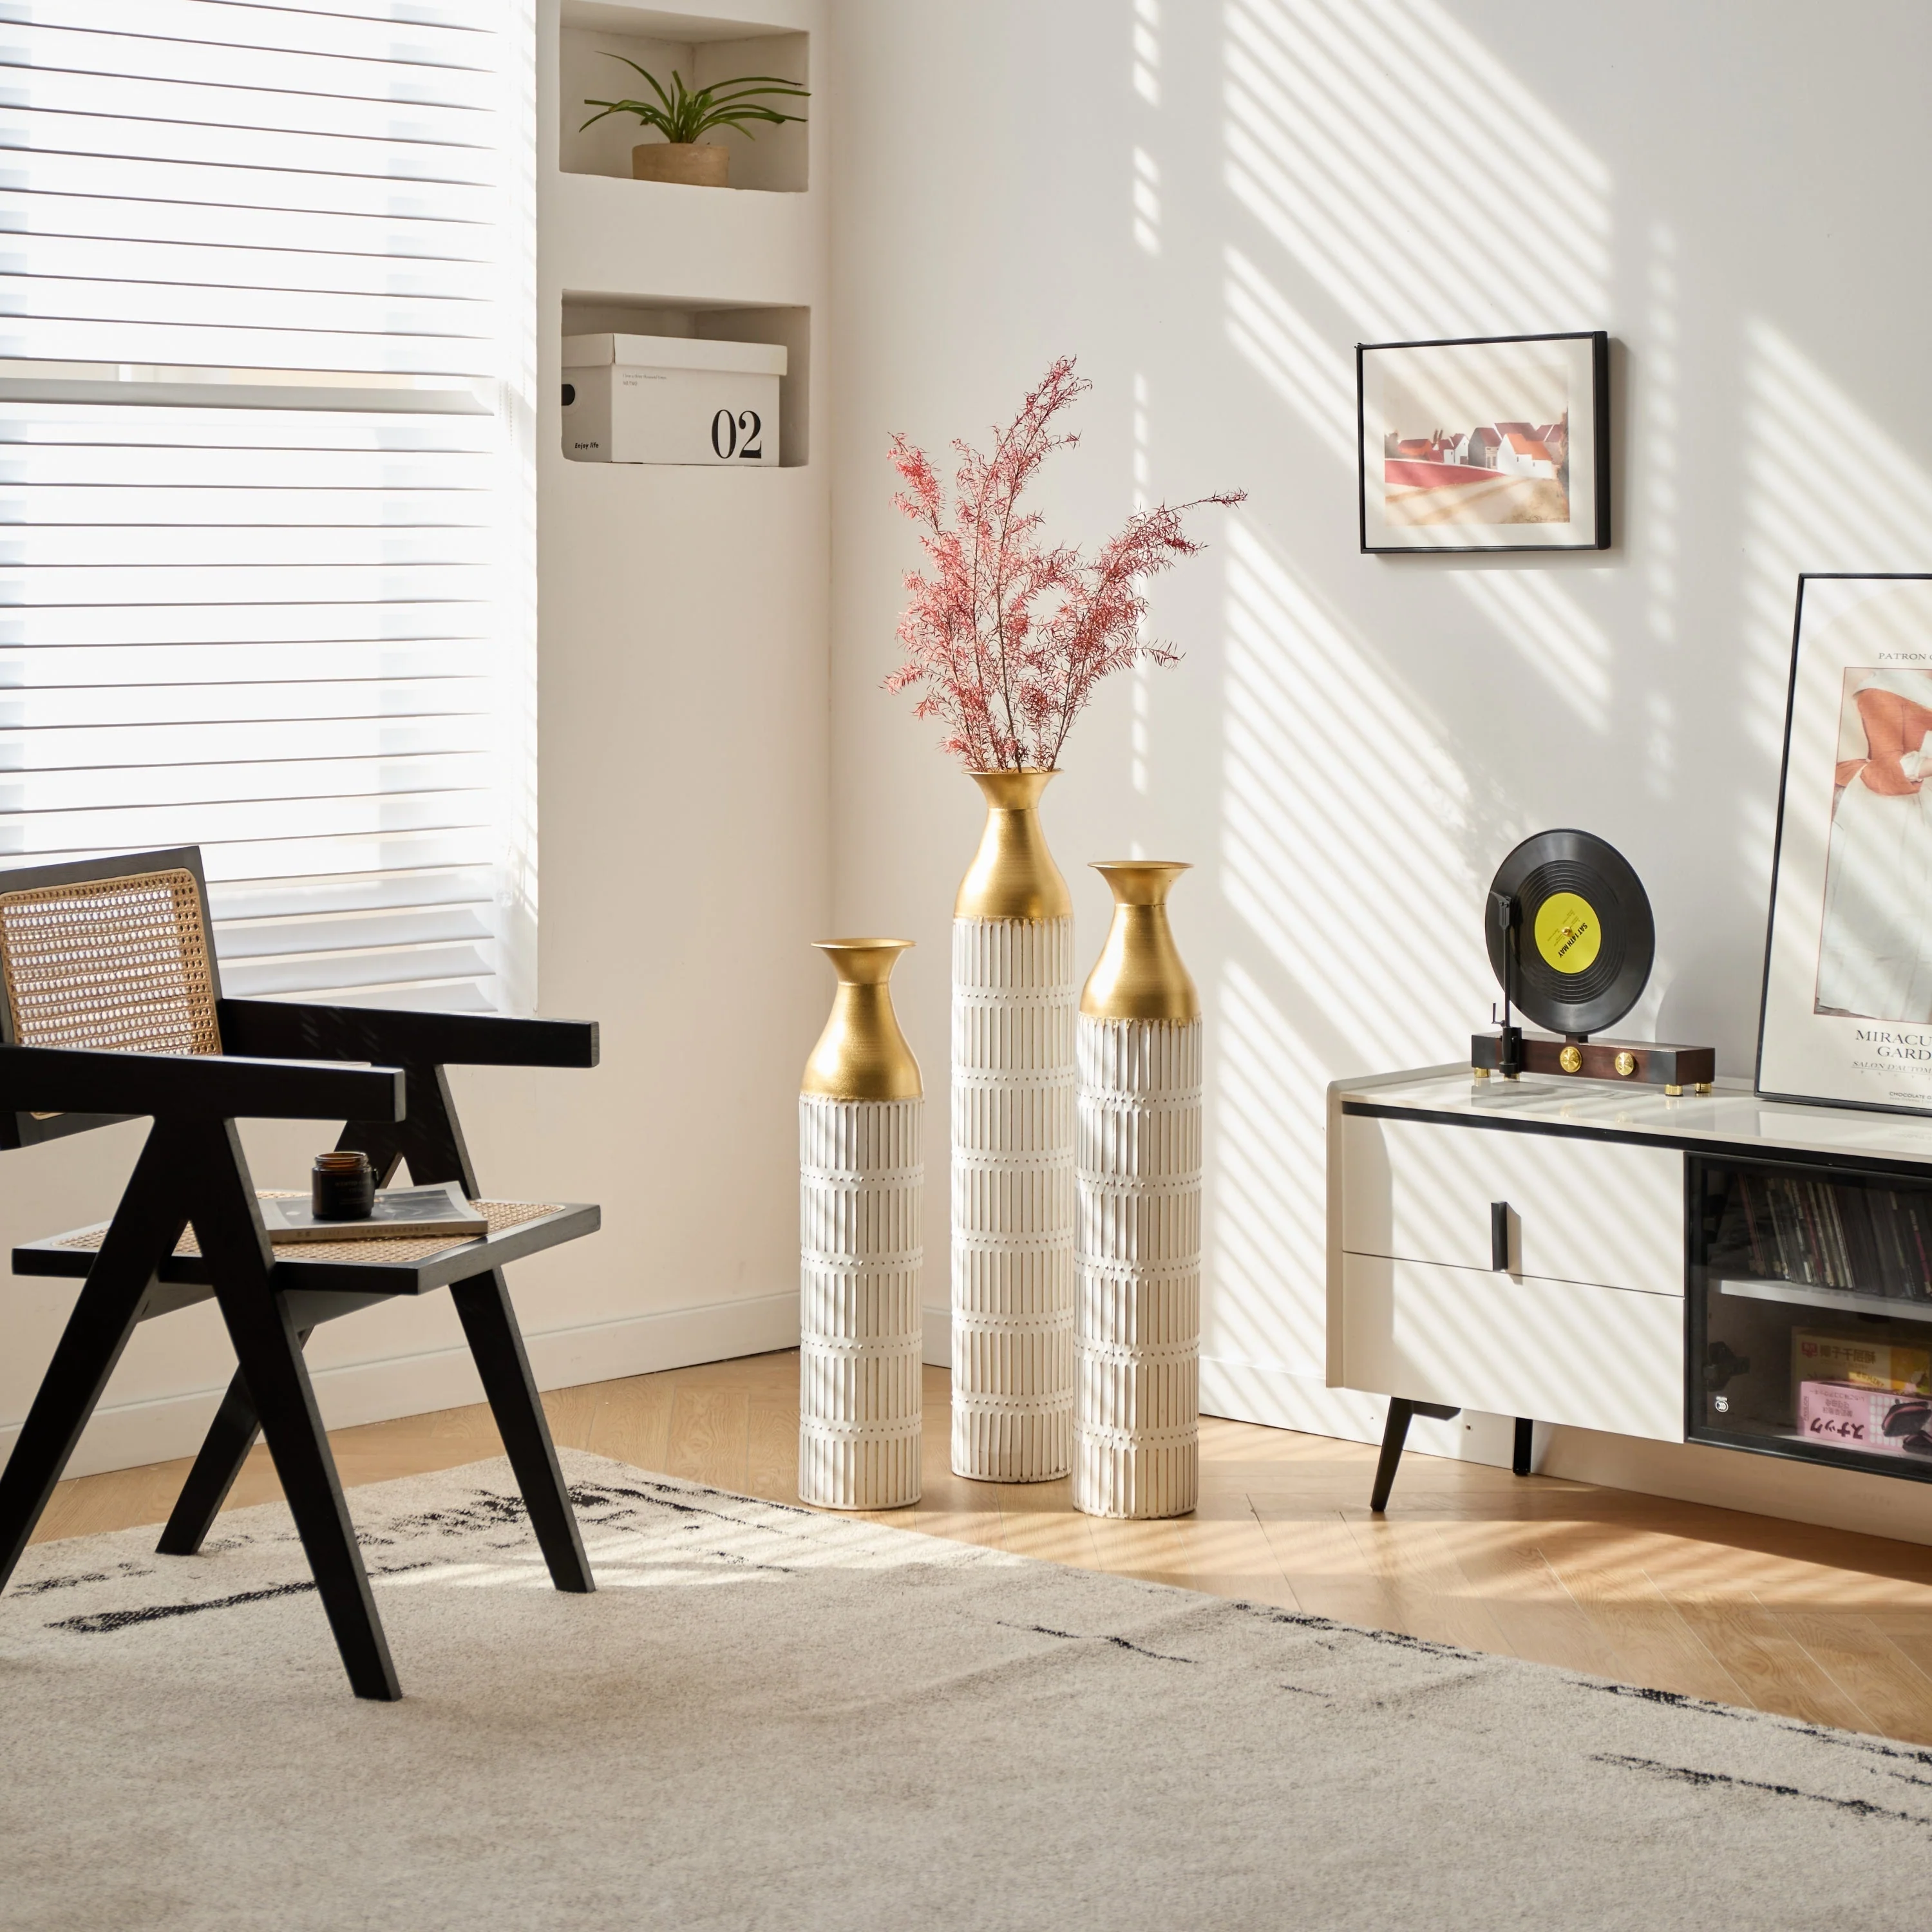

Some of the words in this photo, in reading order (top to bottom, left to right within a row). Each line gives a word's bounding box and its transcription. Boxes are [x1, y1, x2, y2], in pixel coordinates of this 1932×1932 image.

[711, 409, 762, 459] 02
[1577, 922, 1588, 935] SAT
[1568, 933, 1579, 947] 14TH
[1558, 945, 1570, 958] MAY
[1856, 1030, 1932, 1046] MIRACU
[1877, 1046, 1931, 1060] GARD
[1810, 1417, 1865, 1440] スナック
